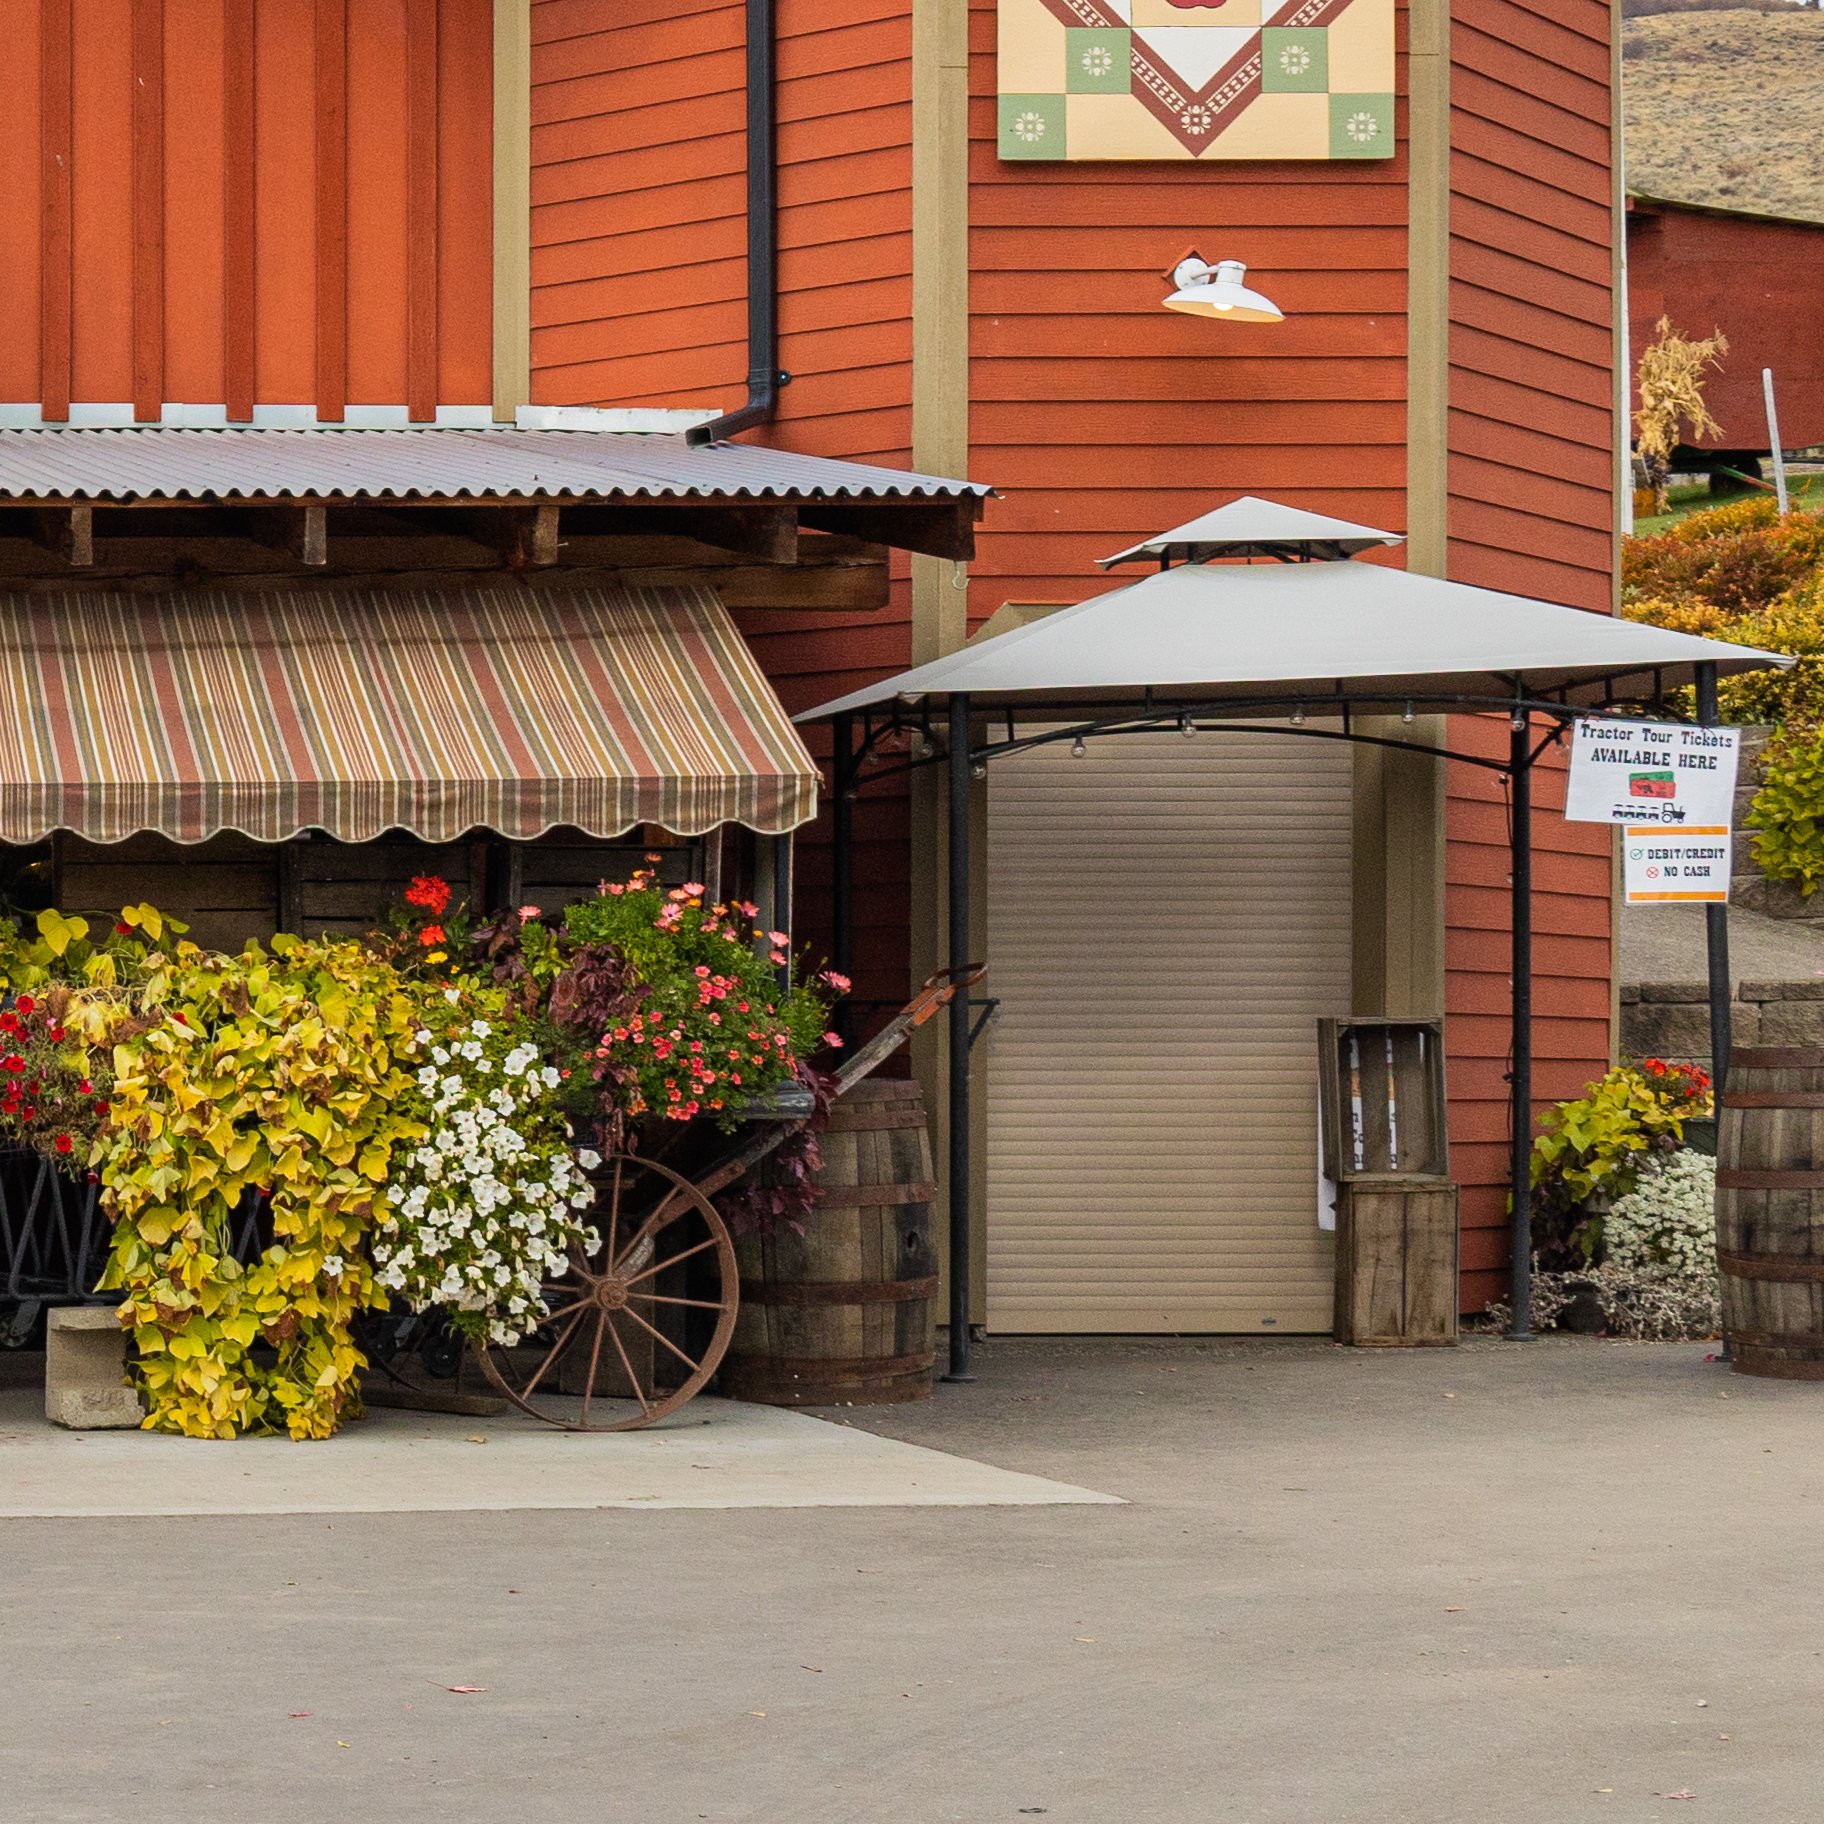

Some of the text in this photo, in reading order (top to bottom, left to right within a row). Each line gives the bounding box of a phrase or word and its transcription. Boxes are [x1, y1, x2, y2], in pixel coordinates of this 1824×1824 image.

[1580, 723, 1733, 748] Tractor Tour Tickets
[1591, 747, 1718, 770] AVAILABLE HERE
[1647, 848, 1726, 860] DEBIT/CREDIT
[1664, 866, 1711, 877] NO CASH
